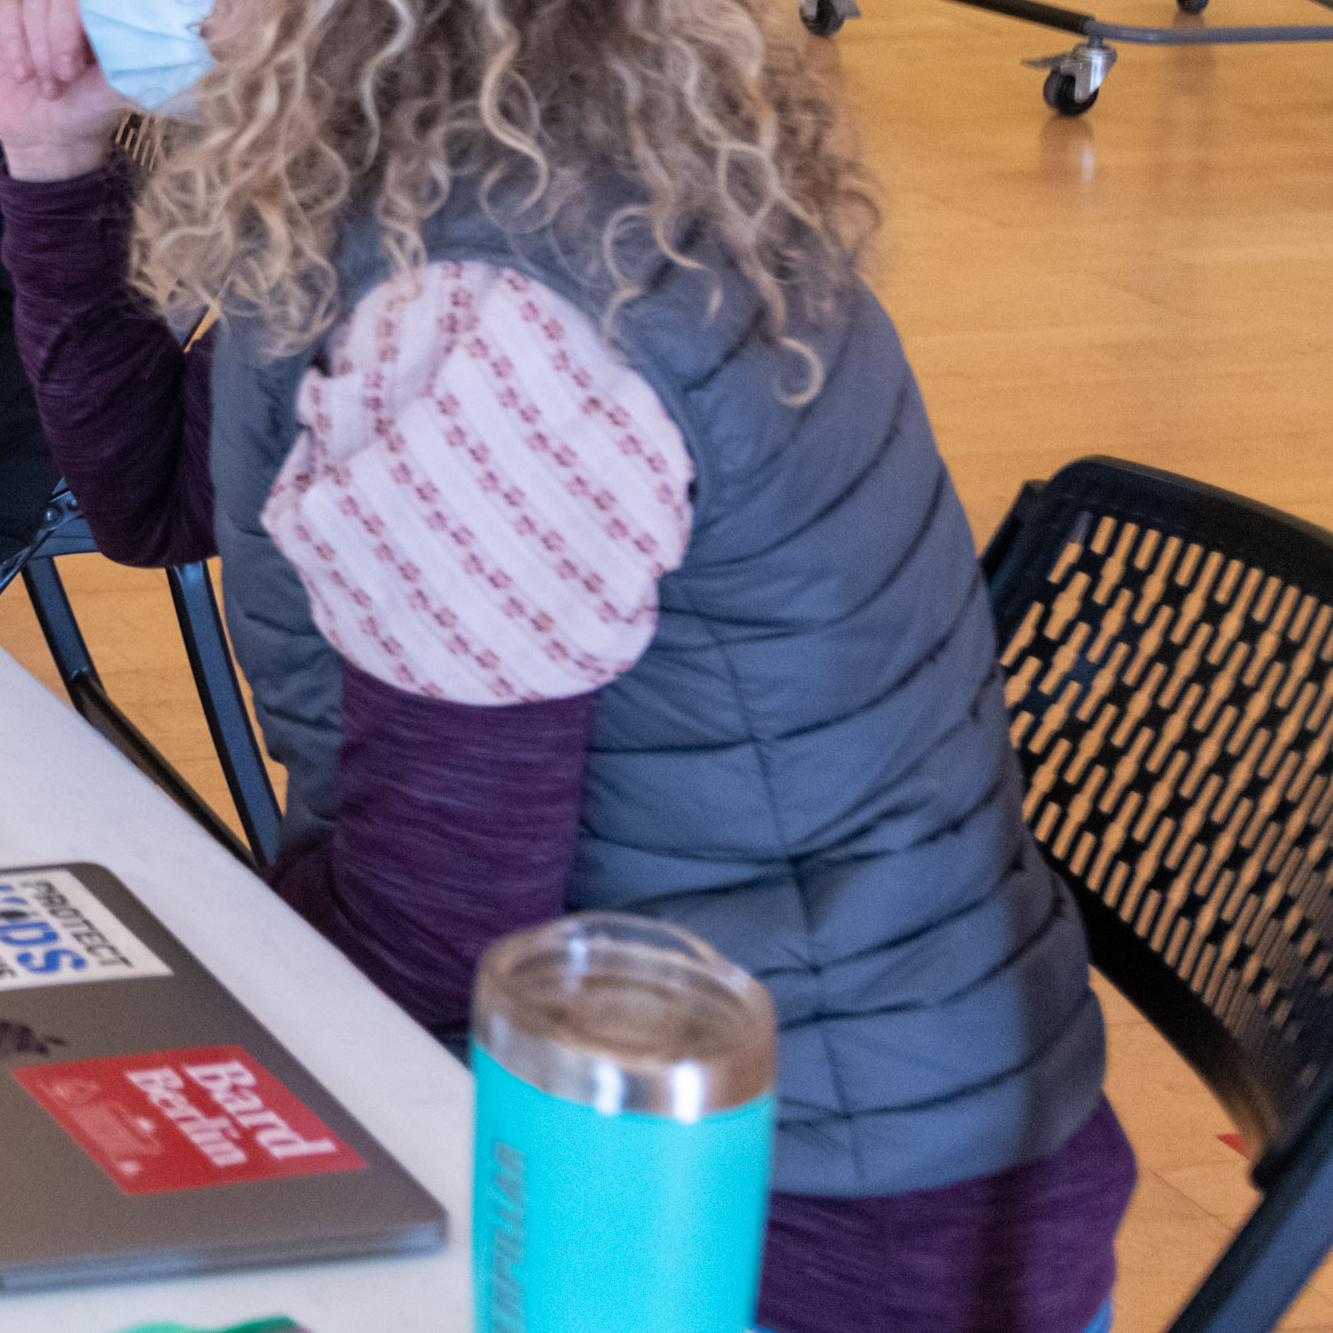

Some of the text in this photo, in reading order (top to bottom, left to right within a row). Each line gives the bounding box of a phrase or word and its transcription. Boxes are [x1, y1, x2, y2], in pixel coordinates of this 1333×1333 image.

[22, 879, 133, 968] PROTECT
[126, 1066, 249, 1167] Berlin
[184, 1060, 339, 1160] Bard
